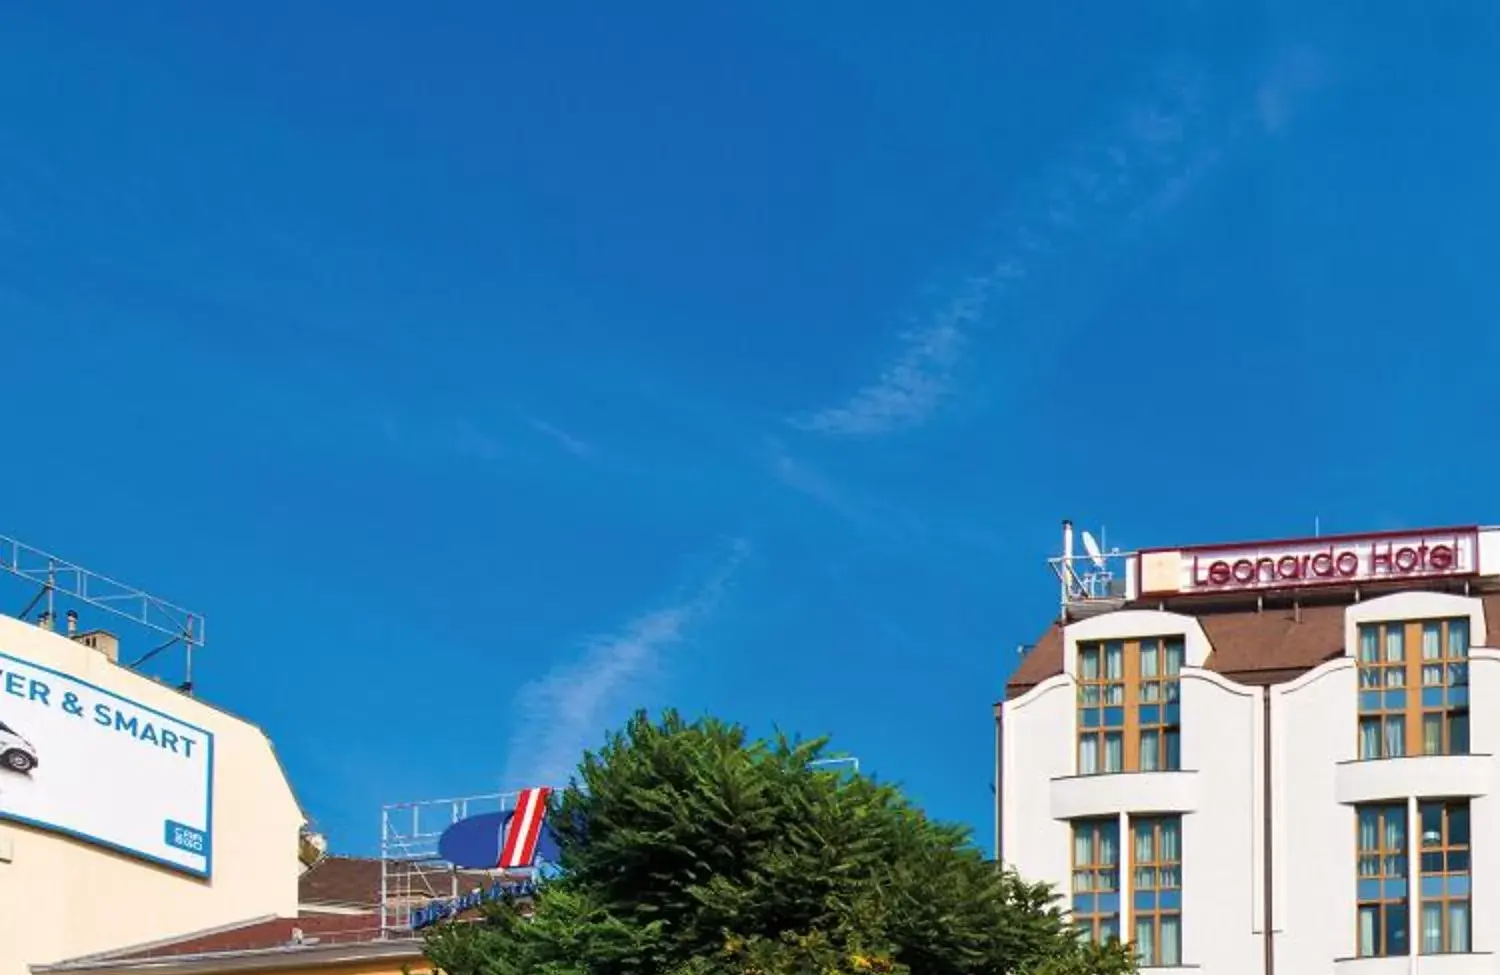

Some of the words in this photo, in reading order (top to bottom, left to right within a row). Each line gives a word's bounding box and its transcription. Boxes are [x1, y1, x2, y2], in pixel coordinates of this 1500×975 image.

[1193, 544, 1360, 586] Leonardo
[1371, 535, 1459, 576] Hotel
[62, 692, 84, 717] &
[94, 703, 197, 759] SMART
